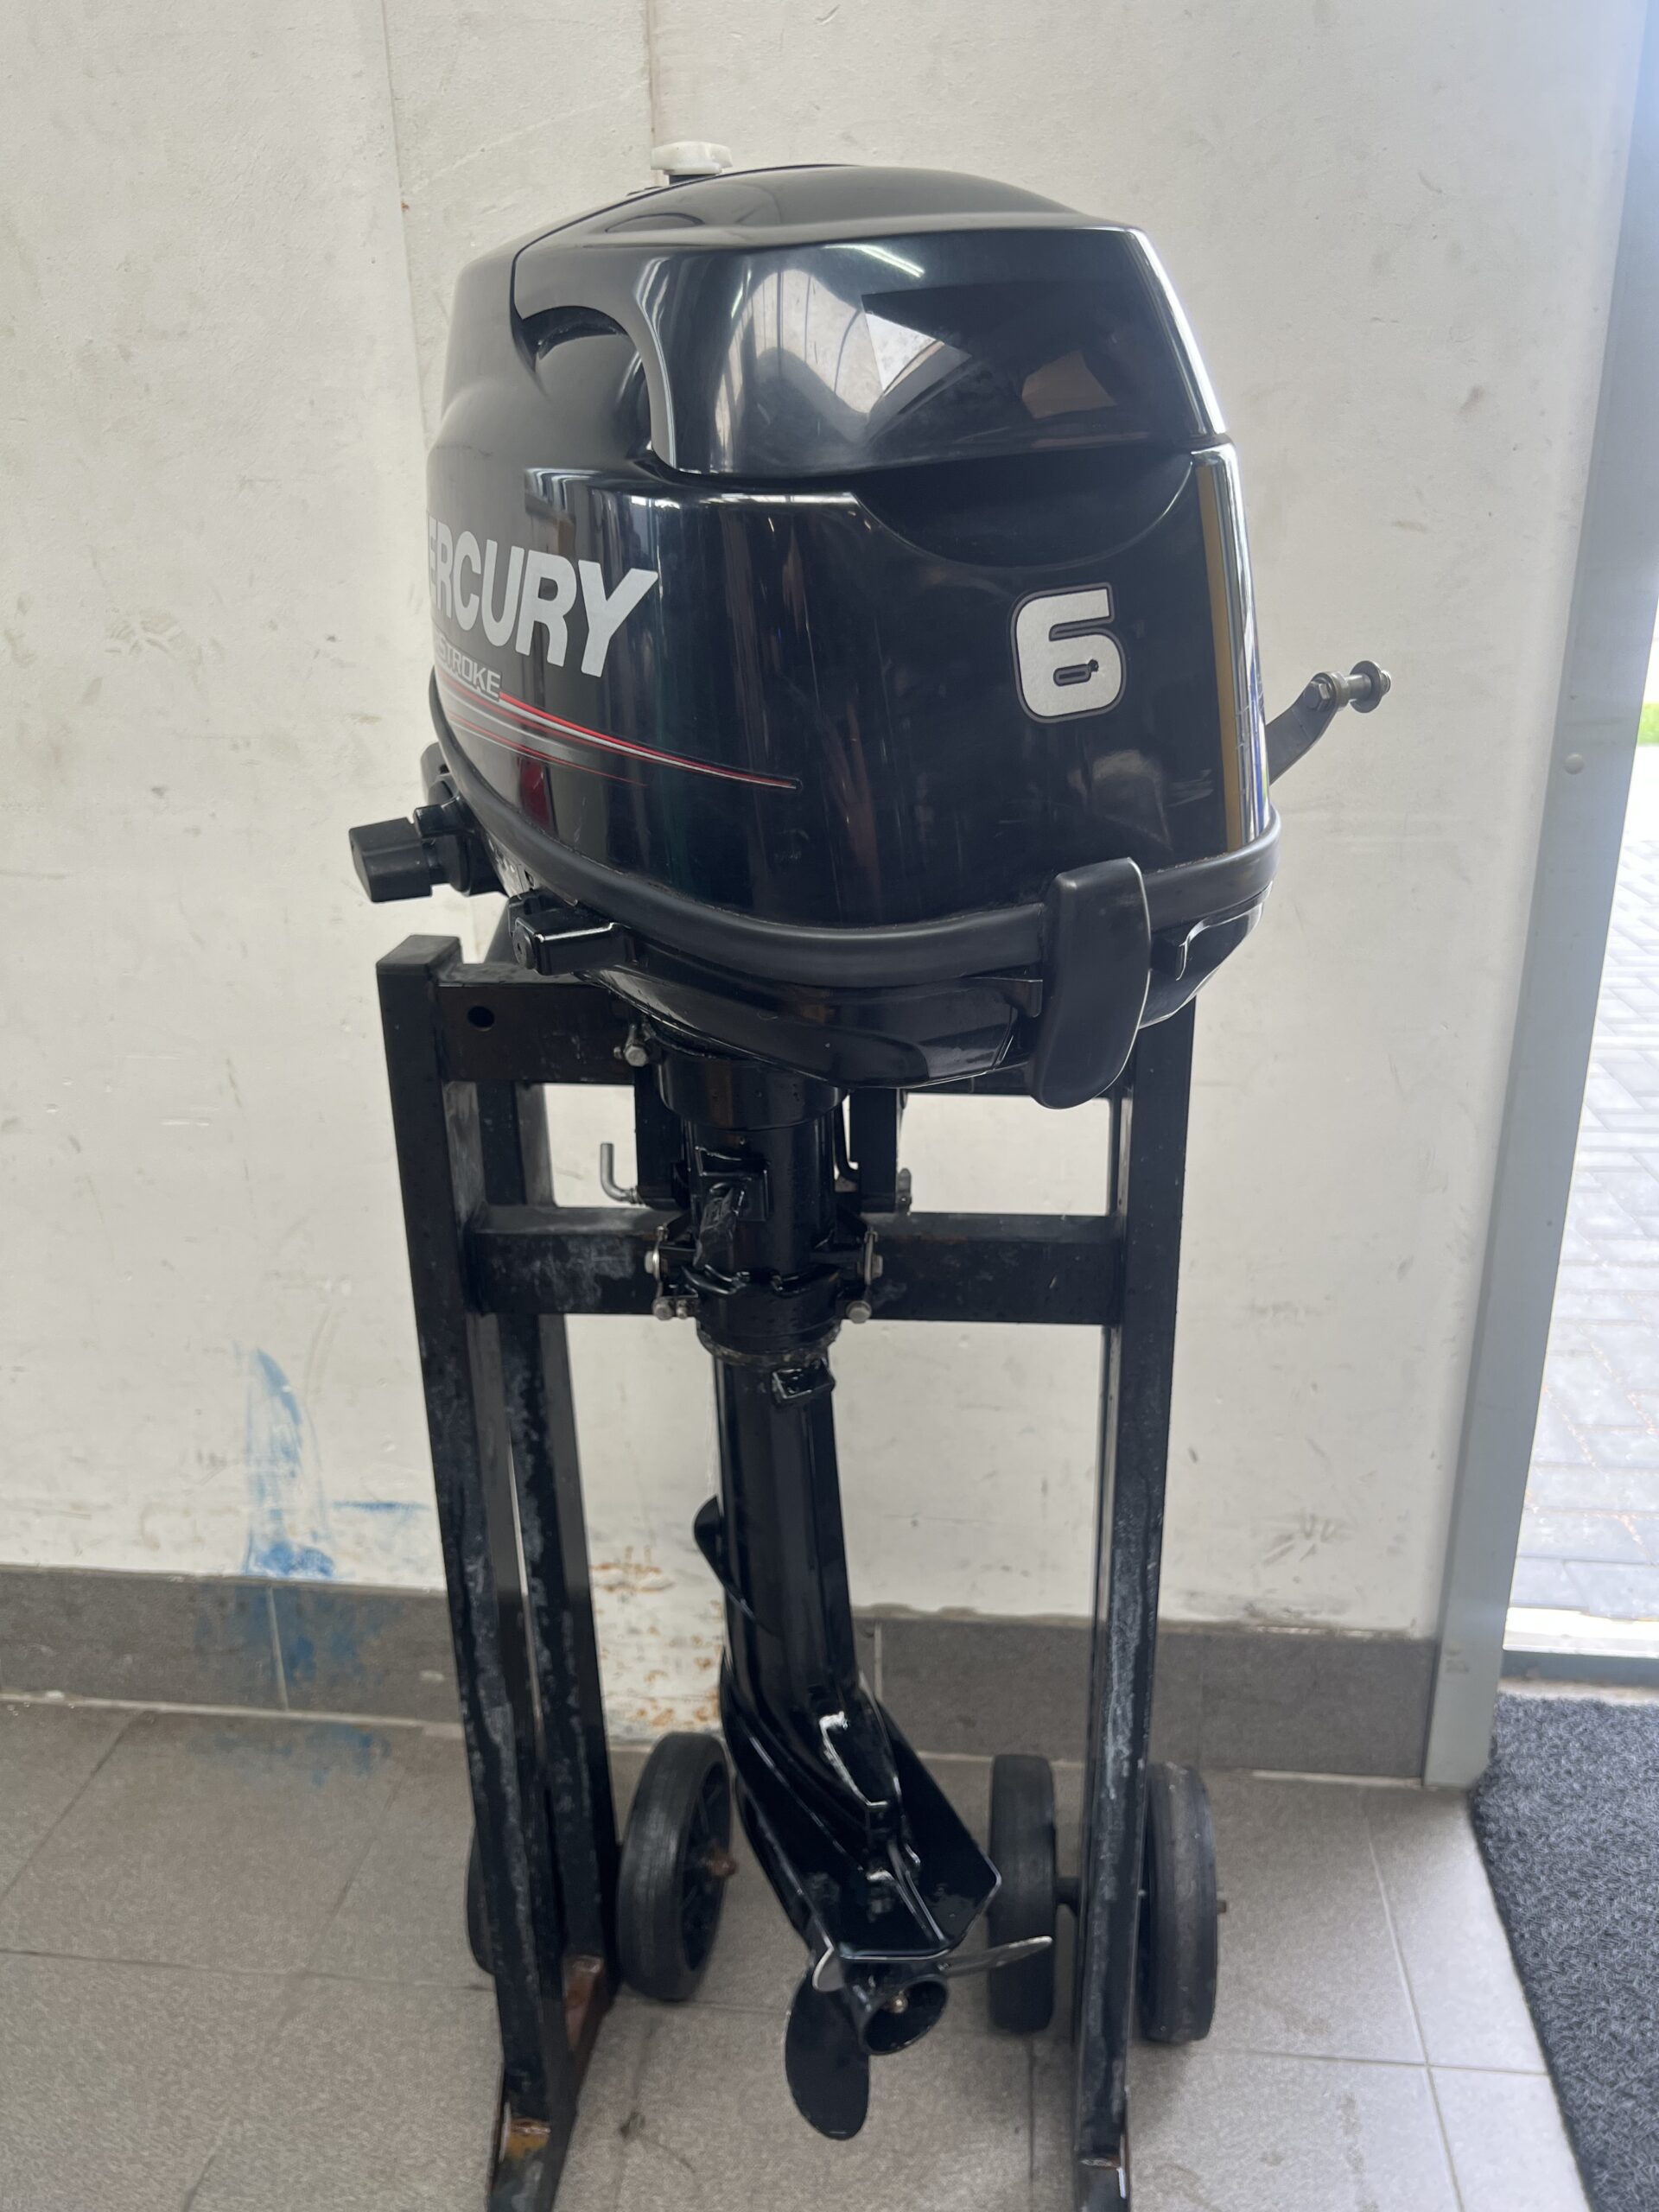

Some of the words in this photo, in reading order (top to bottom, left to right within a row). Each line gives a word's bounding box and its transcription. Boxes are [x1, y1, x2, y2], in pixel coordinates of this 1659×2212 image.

[429, 515, 658, 677] ERCURY
[1014, 585, 1124, 720] 6
[435, 633, 501, 699] STROKE
